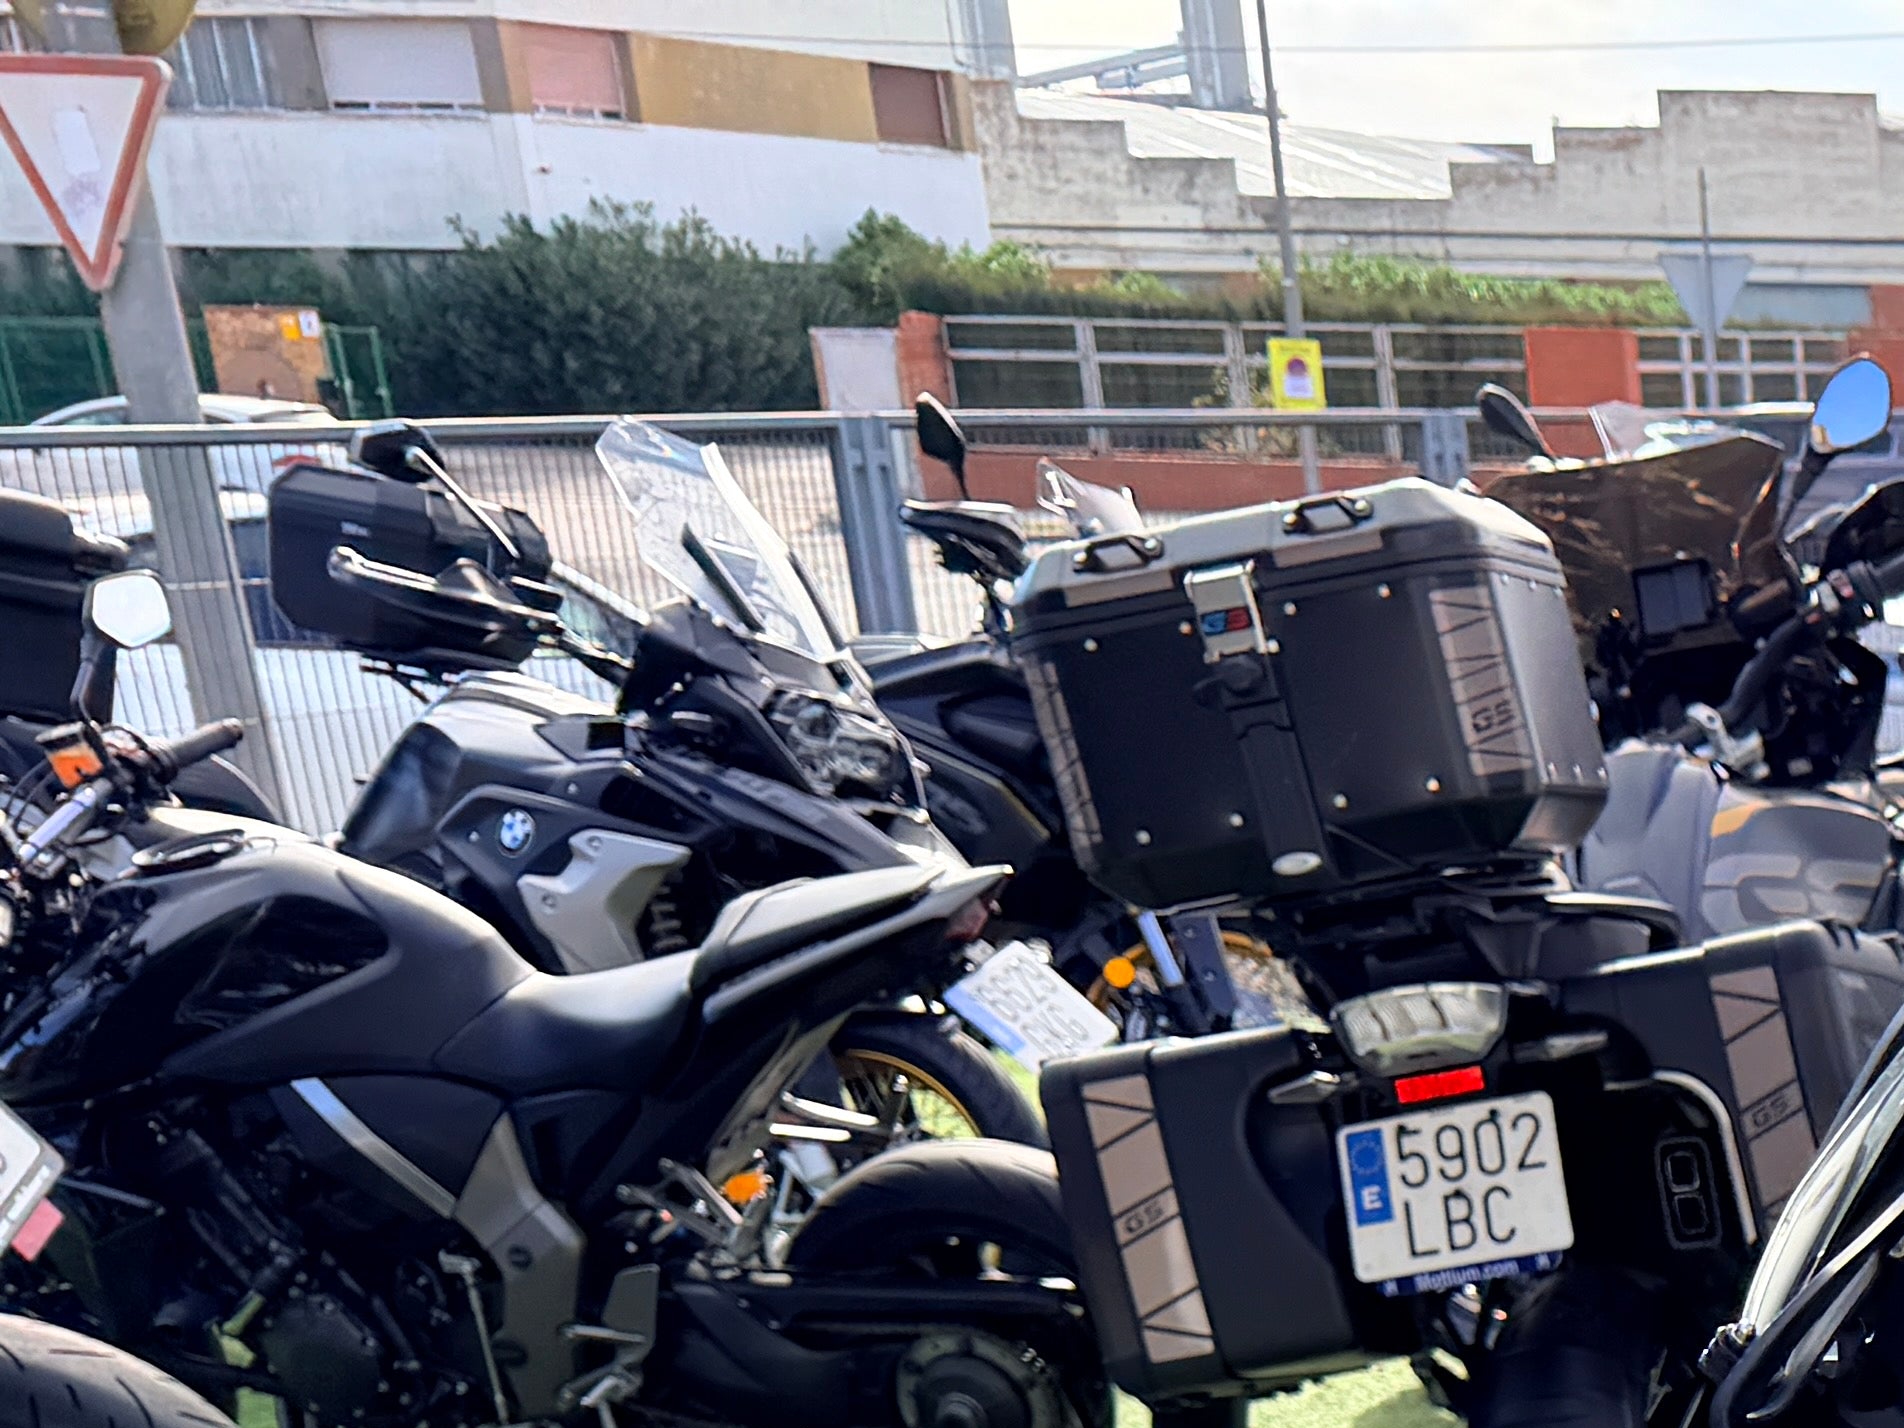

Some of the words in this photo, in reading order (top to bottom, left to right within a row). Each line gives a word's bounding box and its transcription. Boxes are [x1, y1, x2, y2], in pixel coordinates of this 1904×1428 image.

[1396, 1112, 1547, 1188] 5902
[1361, 1184, 1384, 1212] E
[1404, 1186, 1516, 1257] LBC
